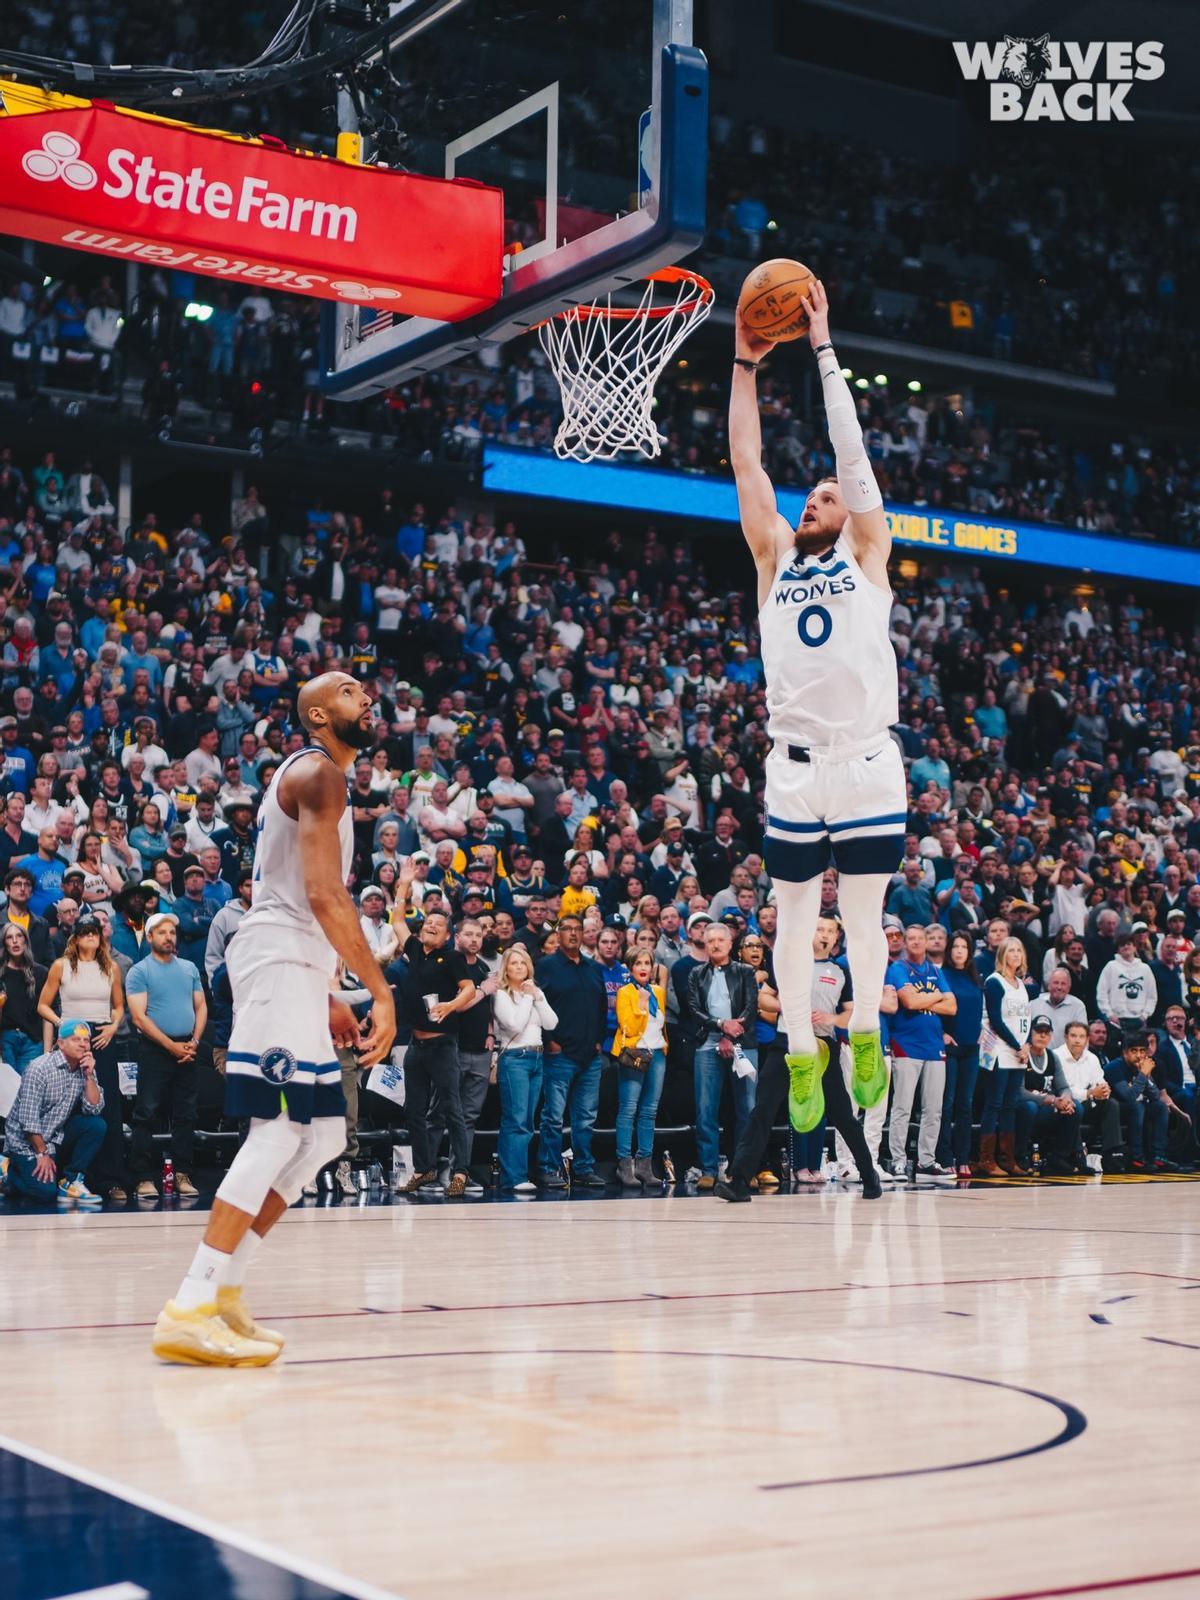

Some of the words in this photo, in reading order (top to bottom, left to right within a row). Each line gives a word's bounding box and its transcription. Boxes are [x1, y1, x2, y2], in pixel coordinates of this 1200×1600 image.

[954, 521, 1017, 555] GAMES
[775, 575, 856, 606] WOLVES
[797, 604, 833, 648] 0
[1019, 1019, 1028, 1033] 15
